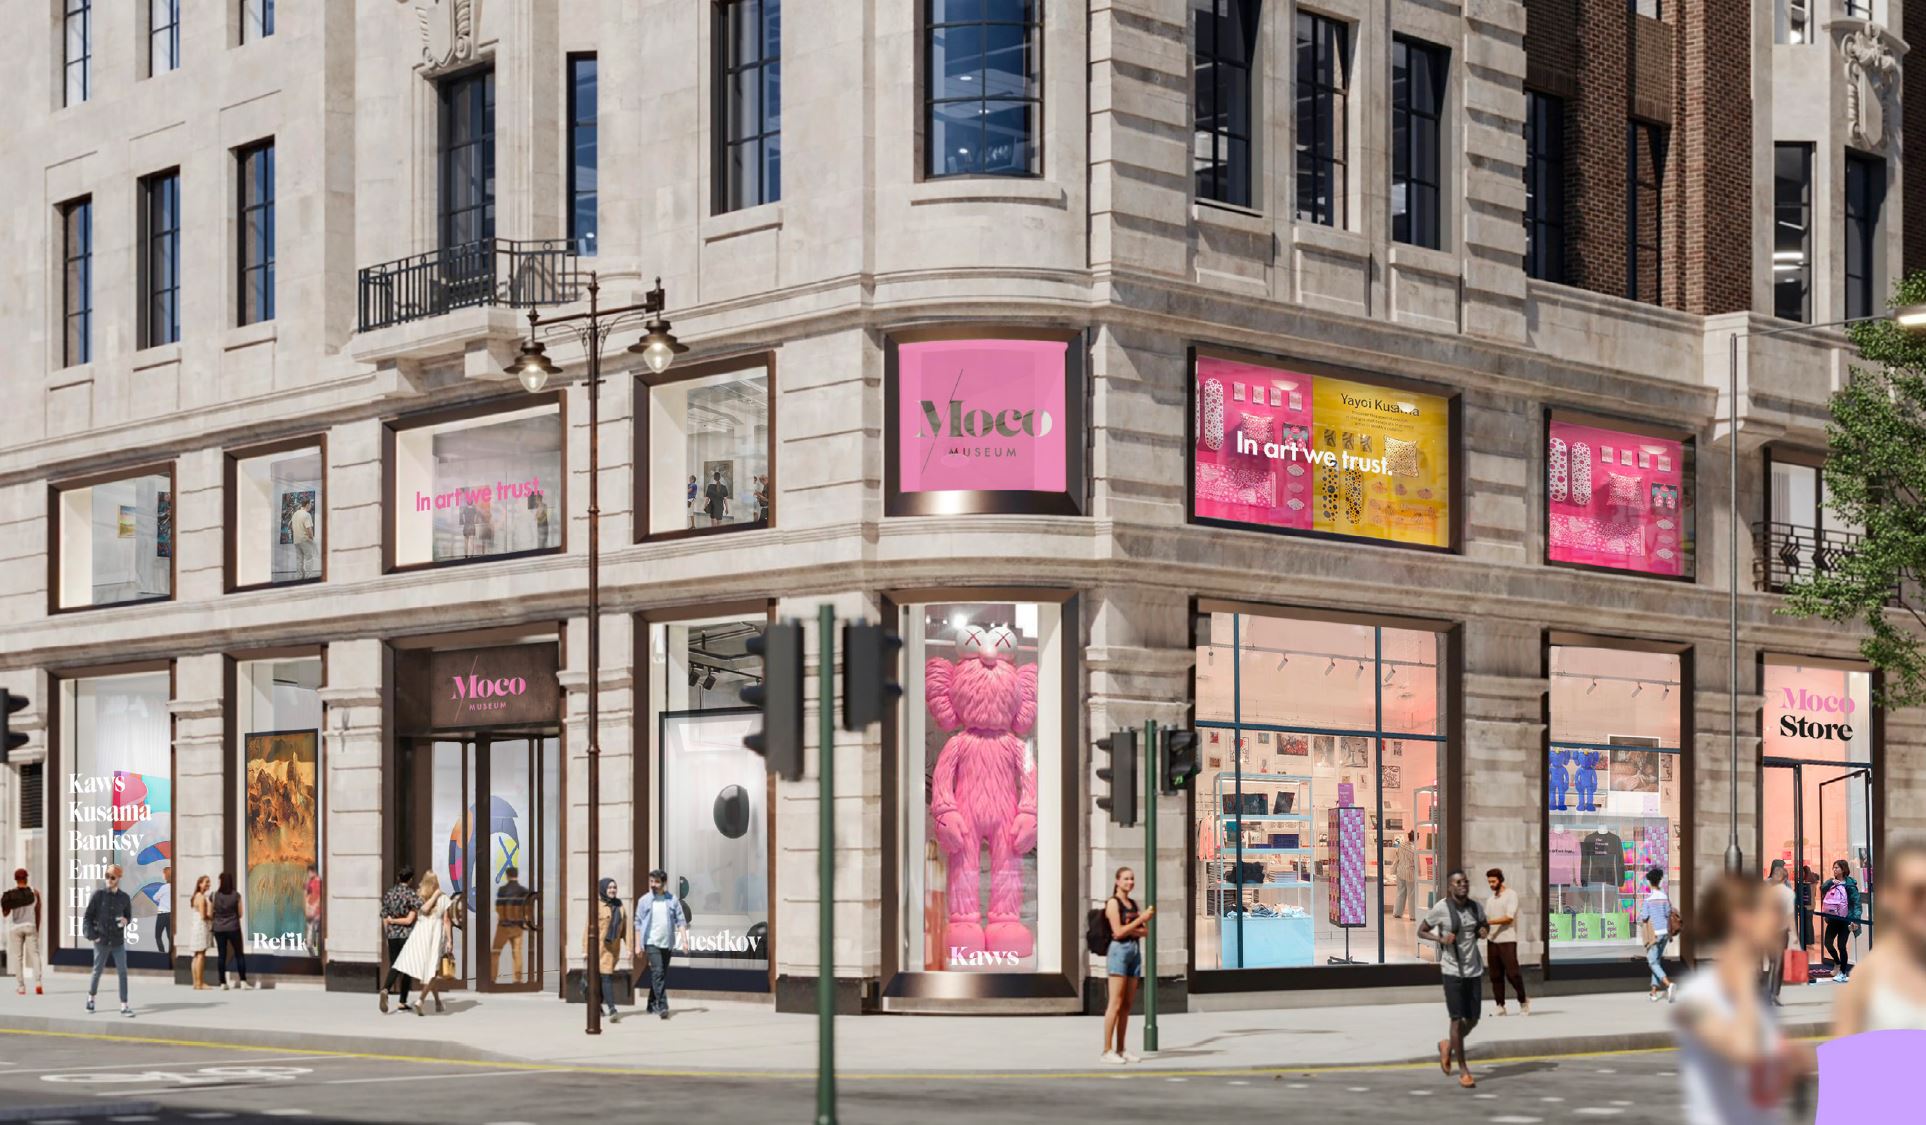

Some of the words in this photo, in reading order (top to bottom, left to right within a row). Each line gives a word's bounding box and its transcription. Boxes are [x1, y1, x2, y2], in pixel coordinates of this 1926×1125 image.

[1341, 393, 1371, 408] Yayoi
[914, 400, 1053, 438] Moco
[1237, 431, 1258, 455] In
[1264, 442, 1299, 461] art
[1303, 448, 1338, 467] we
[1342, 450, 1393, 475] trust.
[416, 491, 431, 512] In
[434, 487, 461, 510] art
[464, 486, 492, 504] we
[496, 476, 545, 501] trust.
[451, 675, 527, 700] Moco
[1780, 687, 1856, 713] Moco
[469, 701, 507, 711] MUSEUM
[1780, 714, 1853, 741] Store
[69, 773, 126, 793] Kaws
[69, 801, 152, 822] Kusama
[69, 828, 144, 856] Banksy
[252, 932, 309, 951] Refik
[950, 946, 1020, 966] Kaws
